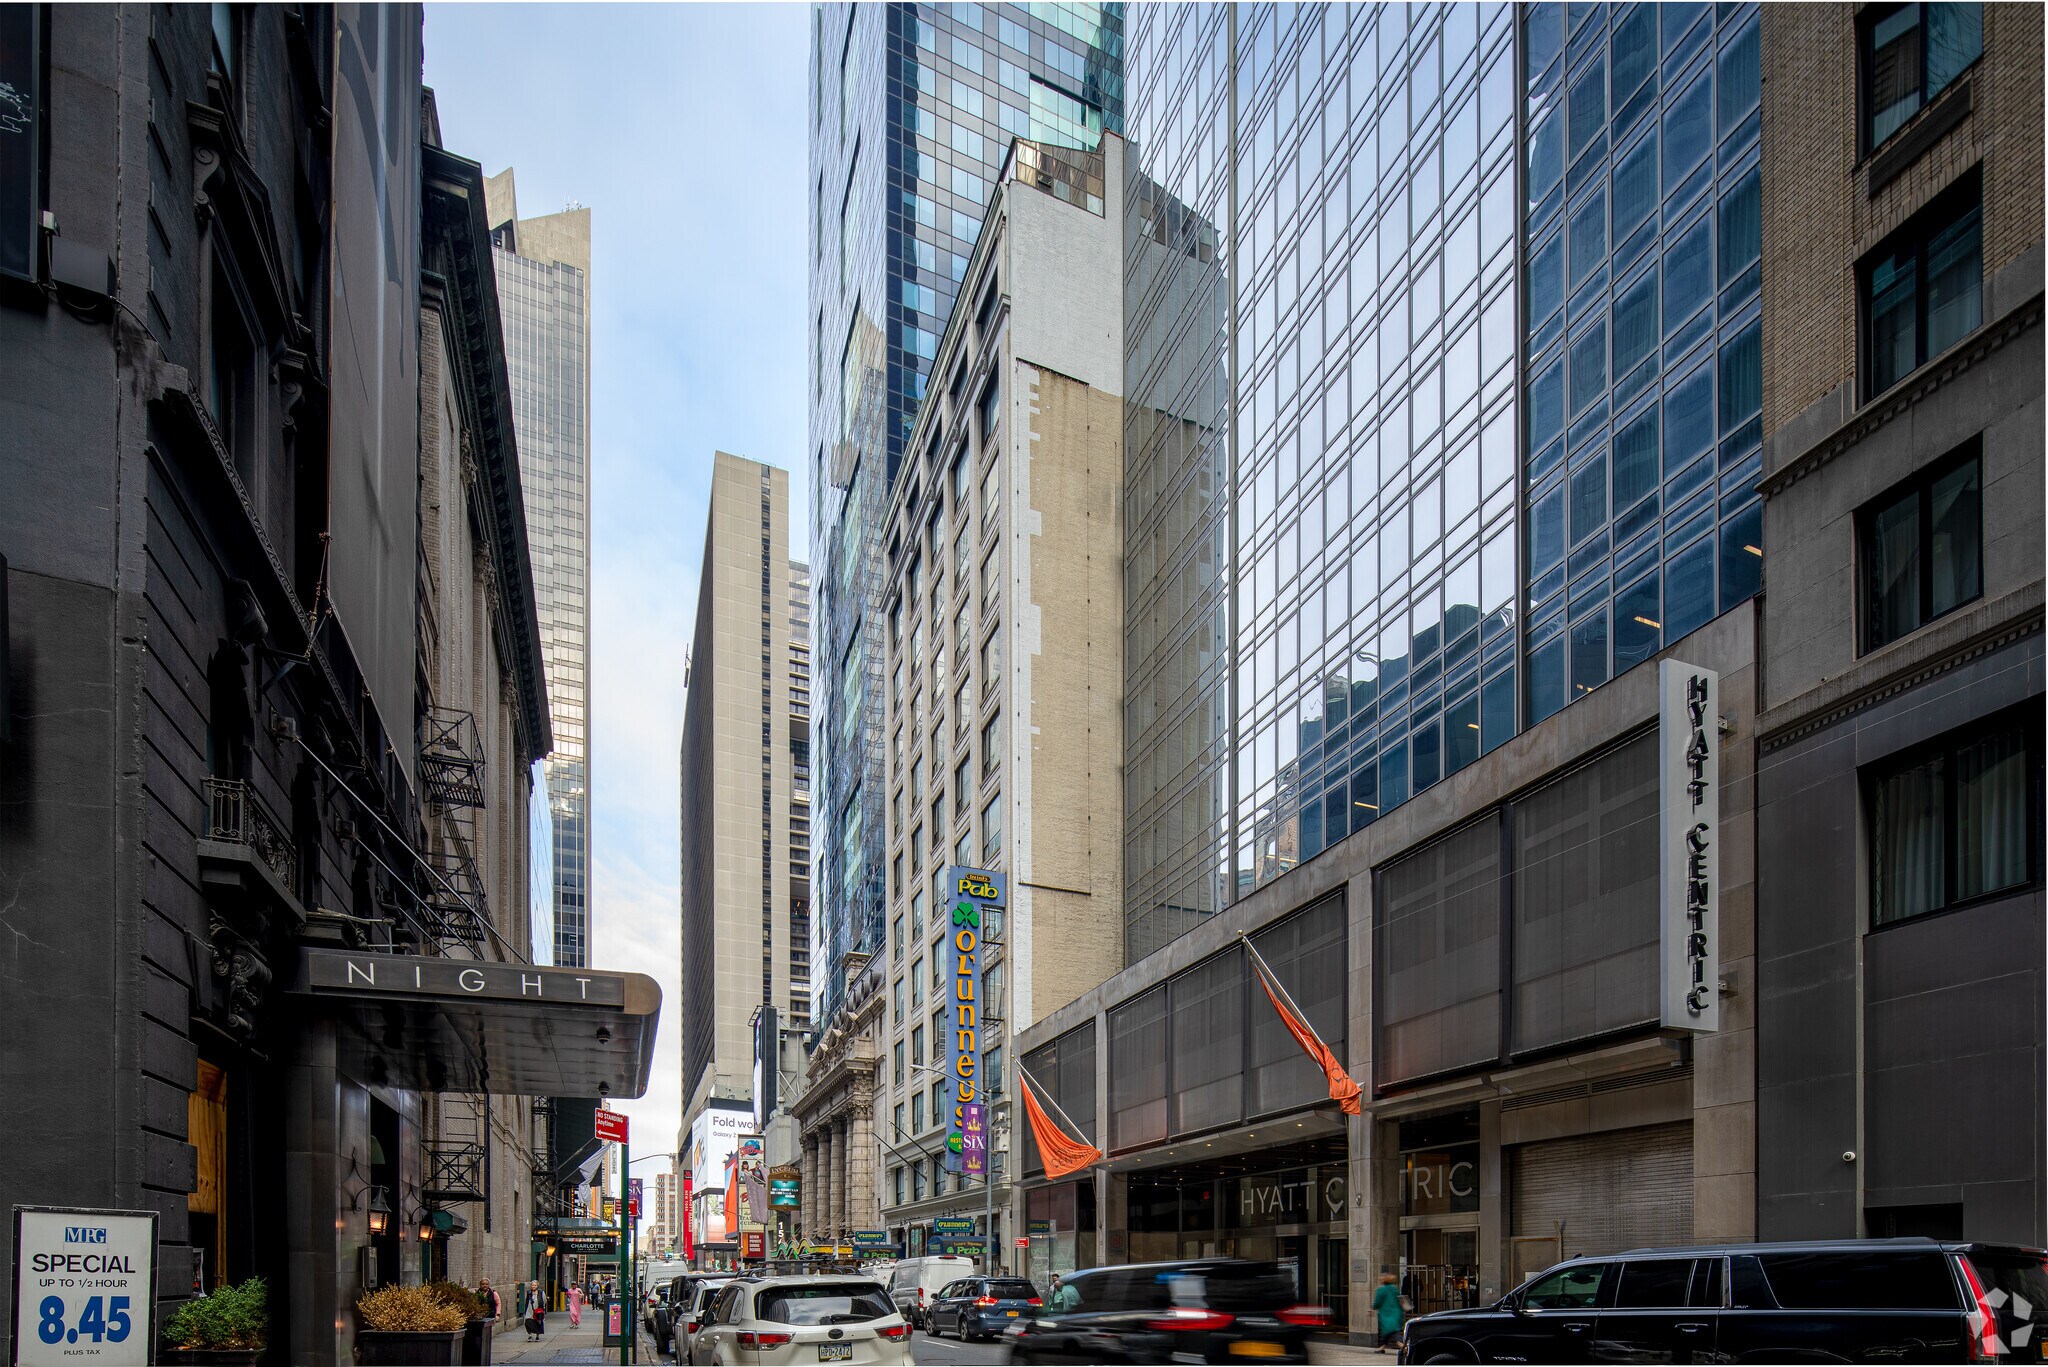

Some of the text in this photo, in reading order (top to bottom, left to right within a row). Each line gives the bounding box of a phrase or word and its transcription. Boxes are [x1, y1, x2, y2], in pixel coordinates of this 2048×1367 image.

[1686, 674, 1709, 1012] HYATT CENTRIC
[957, 878, 999, 899] Pub
[347, 960, 592, 1000] NIGHT
[604, 1113, 623, 1123] STANDING
[712, 1116, 736, 1127] Fold
[712, 1131, 732, 1139] Galaxy
[1241, 1180, 1316, 1216] HYATT
[65, 1227, 106, 1243] MPG
[957, 1246, 980, 1255] Pub
[31, 1253, 136, 1274] SPECIAL
[39, 1278, 128, 1288] UP TO 1/2 HOUR
[38, 1295, 131, 1344] 8.45
